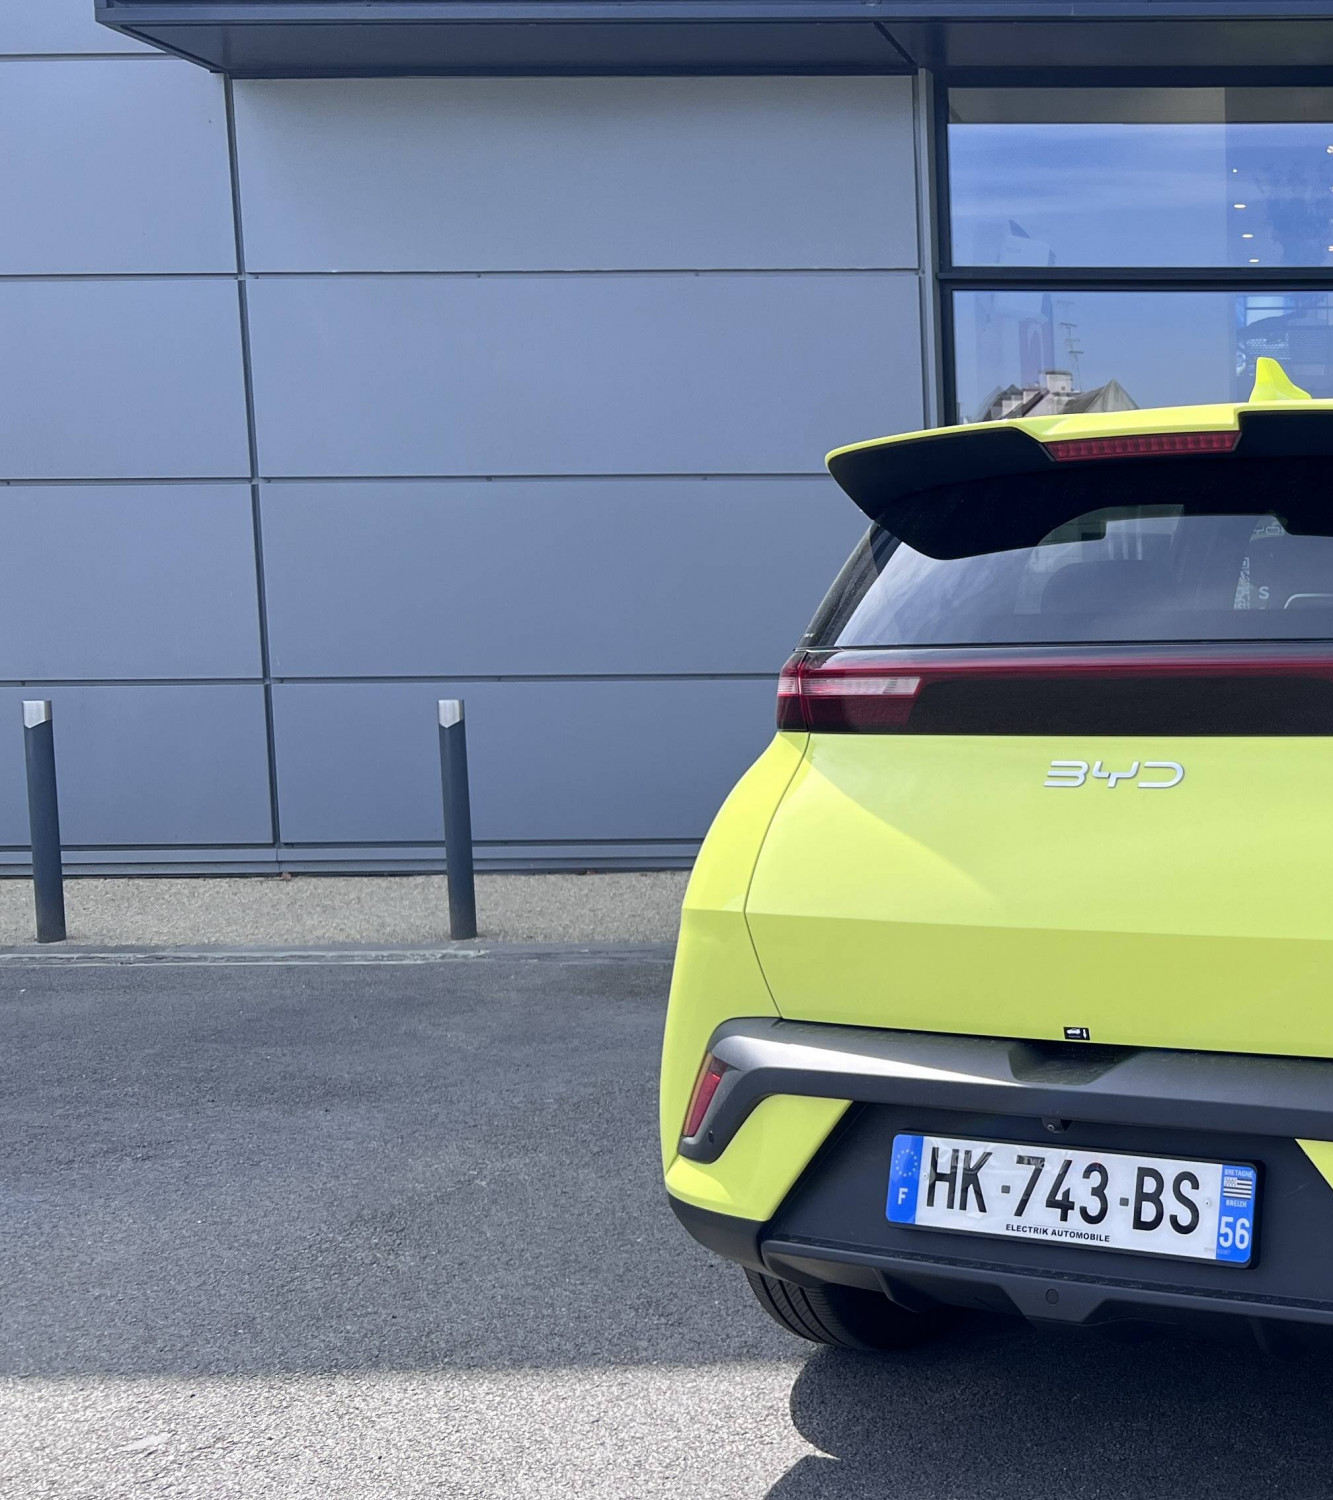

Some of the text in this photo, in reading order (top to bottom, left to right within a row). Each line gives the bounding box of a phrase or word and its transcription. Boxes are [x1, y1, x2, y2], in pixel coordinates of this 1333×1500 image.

[1043, 760, 1186, 789] BYD
[1224, 1168, 1253, 1178] BRETAGNE
[897, 1187, 908, 1205] F
[926, 1146, 1201, 1235] HK-743-BS
[1225, 1199, 1247, 1208] BREIZH
[1005, 1223, 1111, 1243] ELECTRIK AUTOMOBILE
[1219, 1215, 1250, 1250] 56
